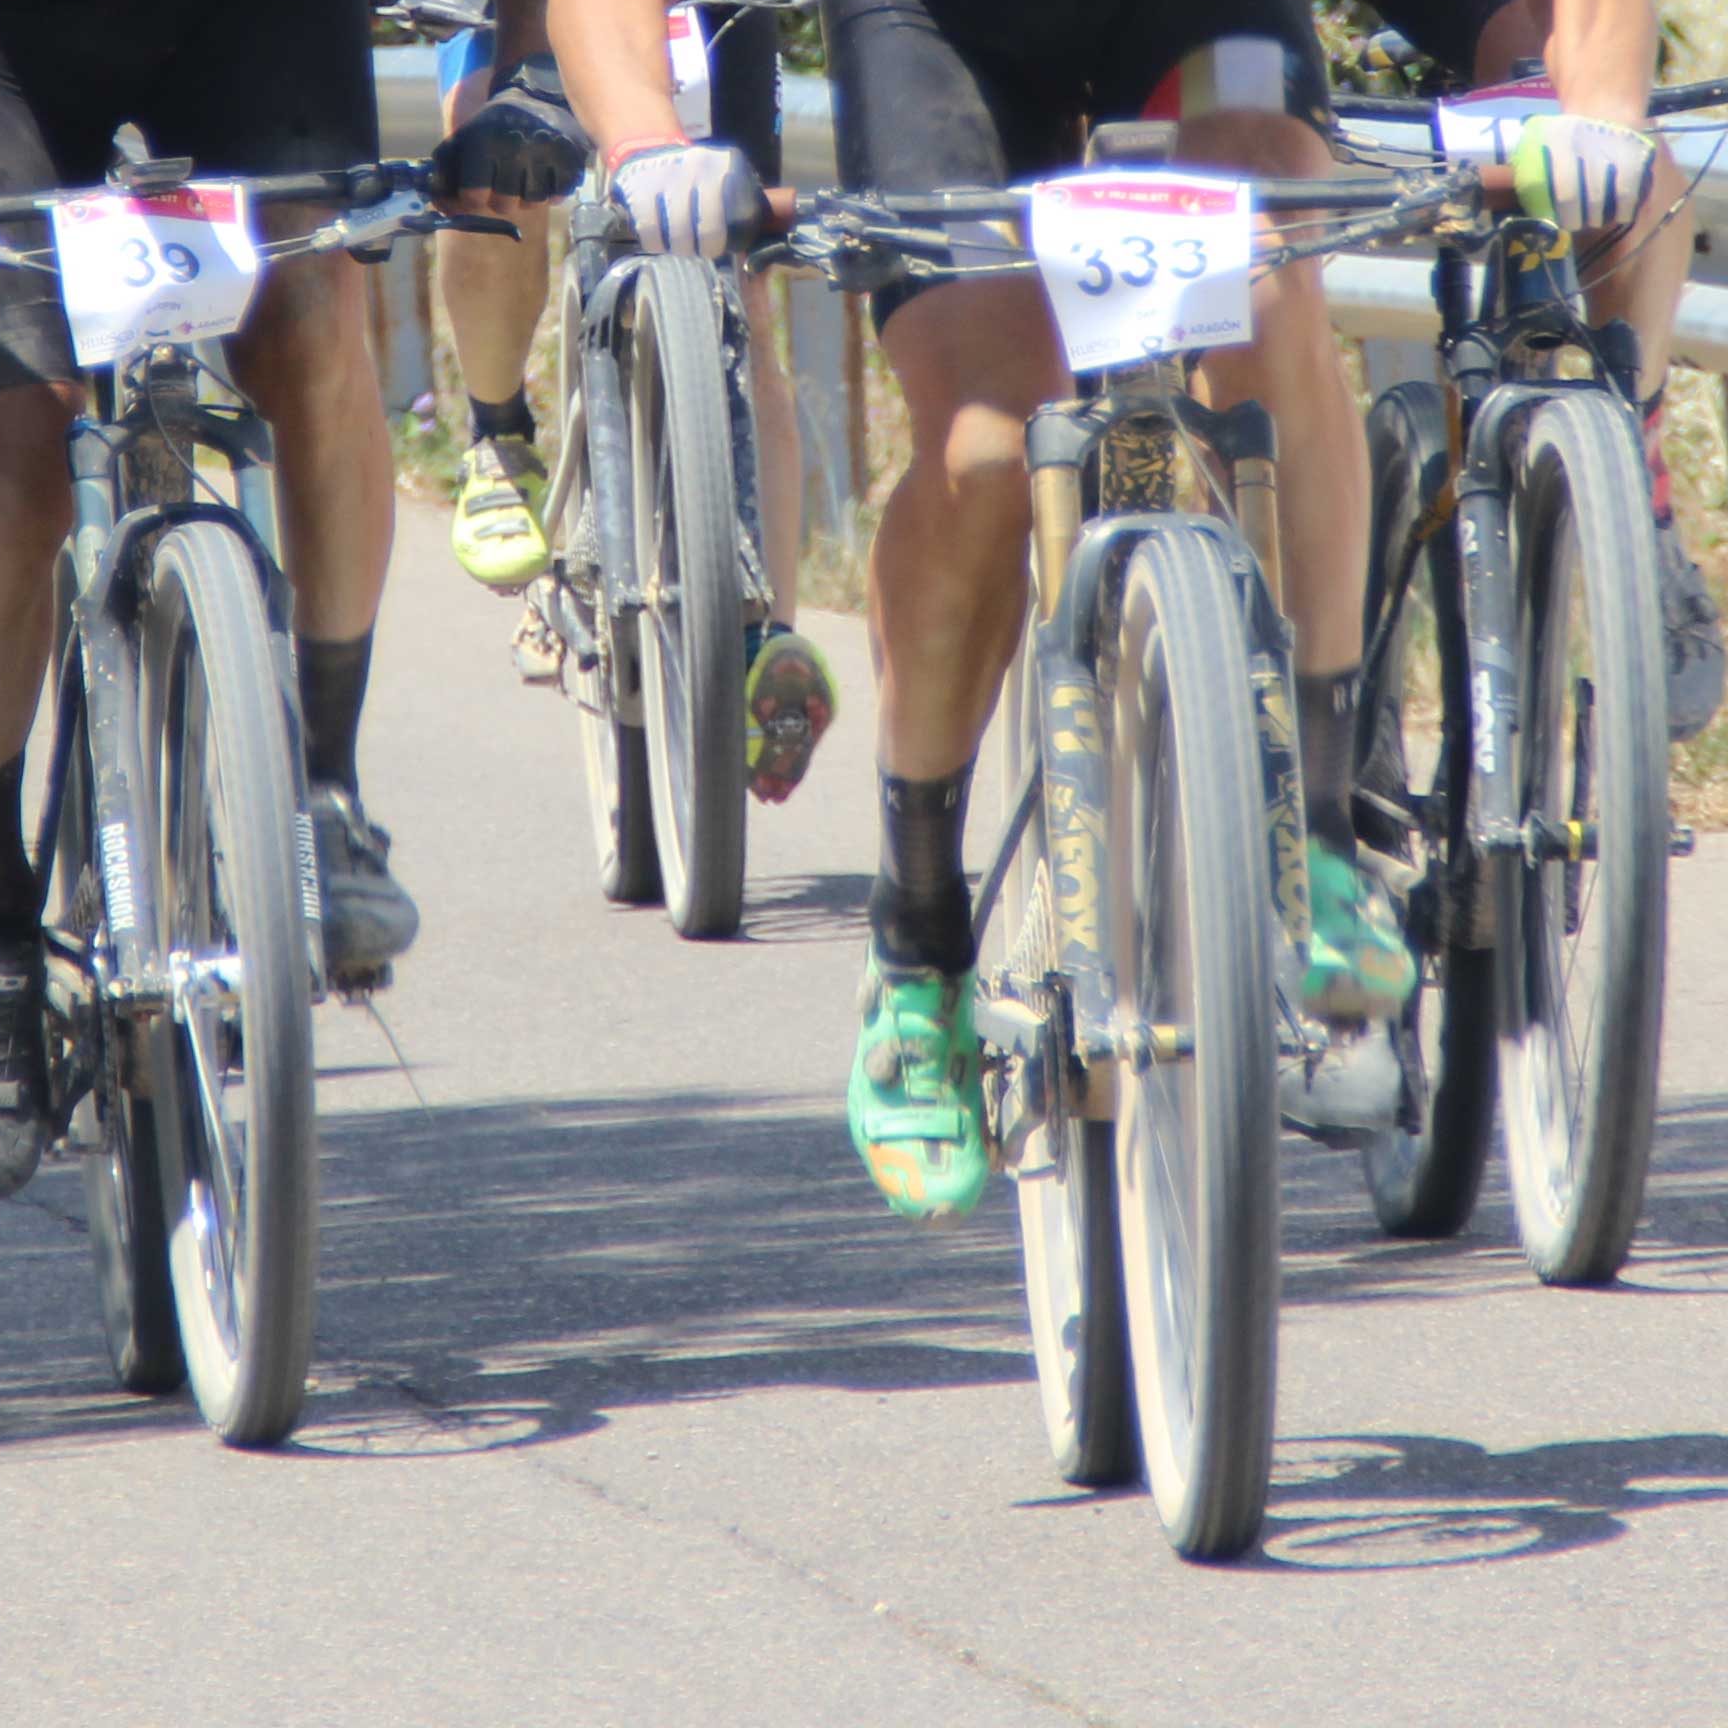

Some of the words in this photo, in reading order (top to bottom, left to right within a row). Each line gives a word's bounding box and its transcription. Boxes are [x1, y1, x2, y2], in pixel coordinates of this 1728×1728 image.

[121, 238, 201, 288] 39
[1071, 236, 1207, 297] 333
[102, 822, 136, 932] ROCKSHOX
[1051, 831, 1101, 953] FOX
